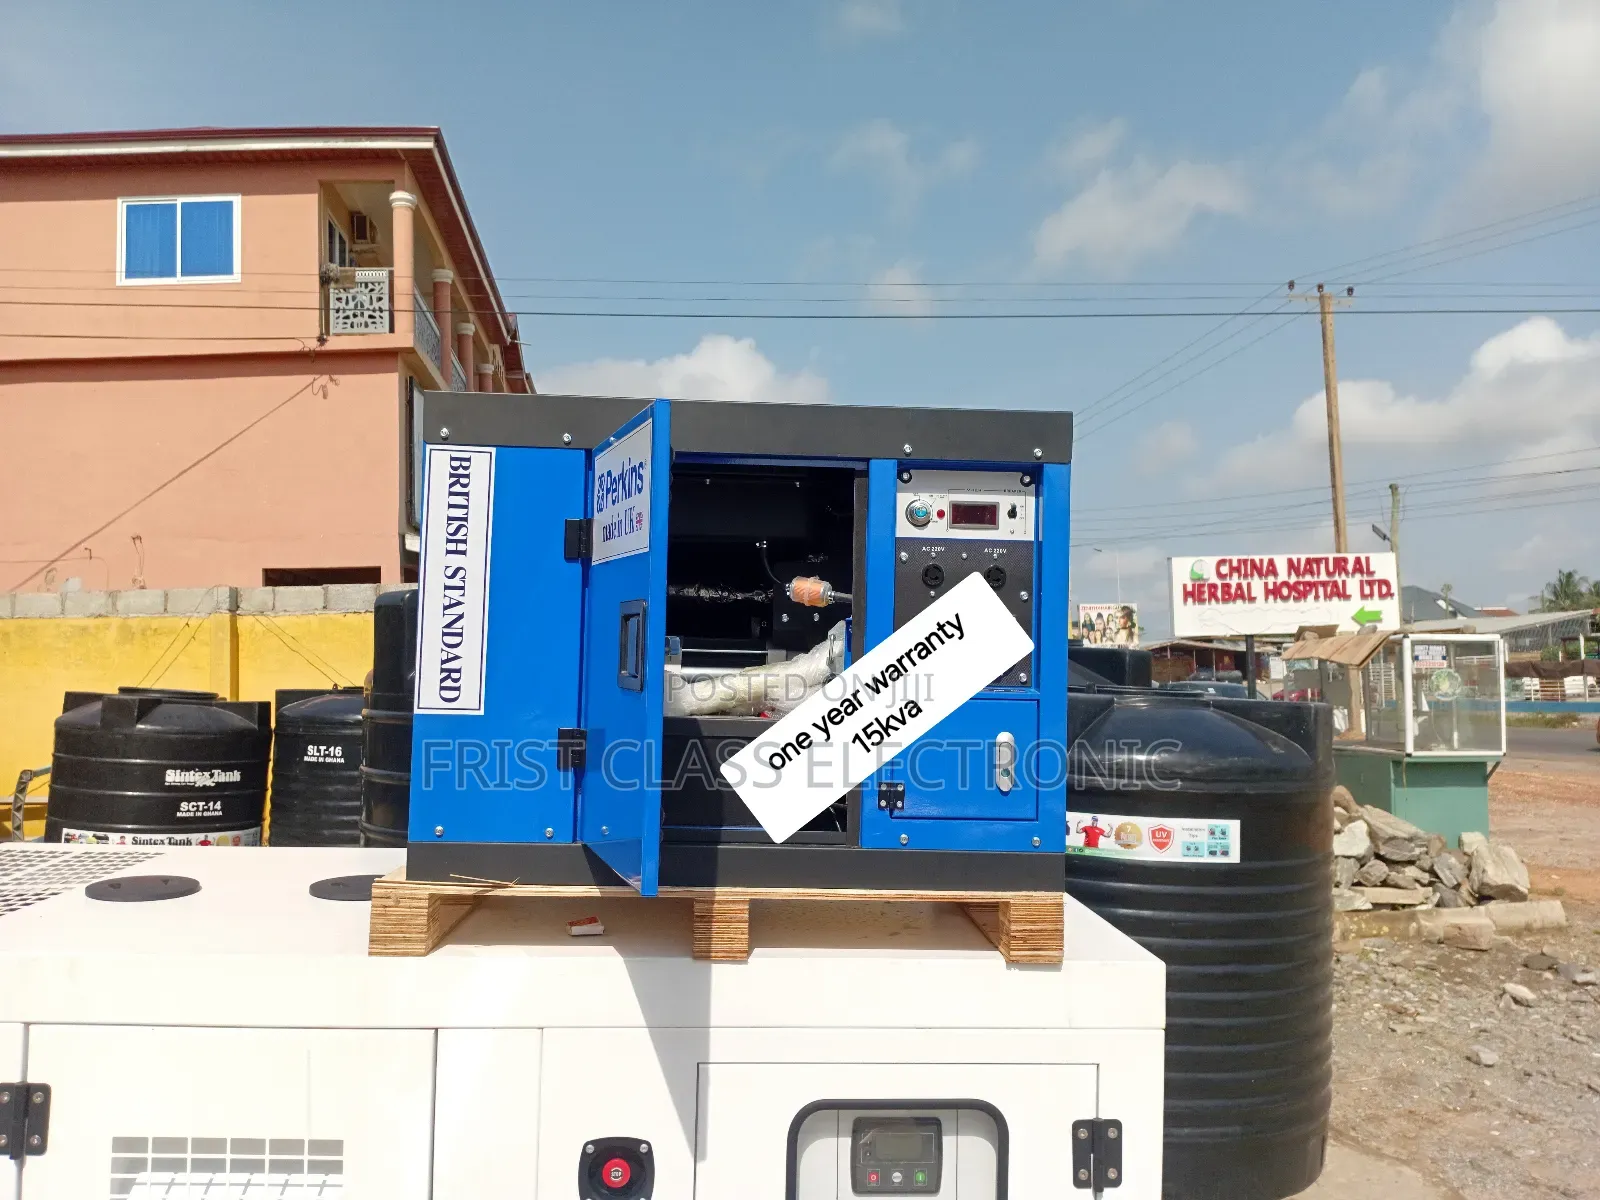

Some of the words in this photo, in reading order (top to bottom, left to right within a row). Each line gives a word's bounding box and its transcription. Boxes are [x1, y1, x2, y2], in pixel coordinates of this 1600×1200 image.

[605, 457, 644, 509] Perkins
[444, 454, 472, 557] BRITISH
[602, 515, 617, 542] made
[624, 506, 635, 535] UK
[1215, 557, 1279, 580] CHINA
[1286, 556, 1376, 578] NATURAL
[1182, 581, 1257, 605] HERBAL
[1263, 579, 1353, 603] HOSPITAL
[1359, 578, 1395, 600] LTD.
[438, 565, 468, 704] STANDARD
[307, 745, 342, 757] SLT-16
[165, 769, 211, 783] Sintex
[211, 769, 242, 783] Tank
[180, 801, 221, 812] SCT-14
[131, 836, 166, 846] Sintex
[167, 836, 193, 846] Tank
[1155, 830, 1168, 839] UV
